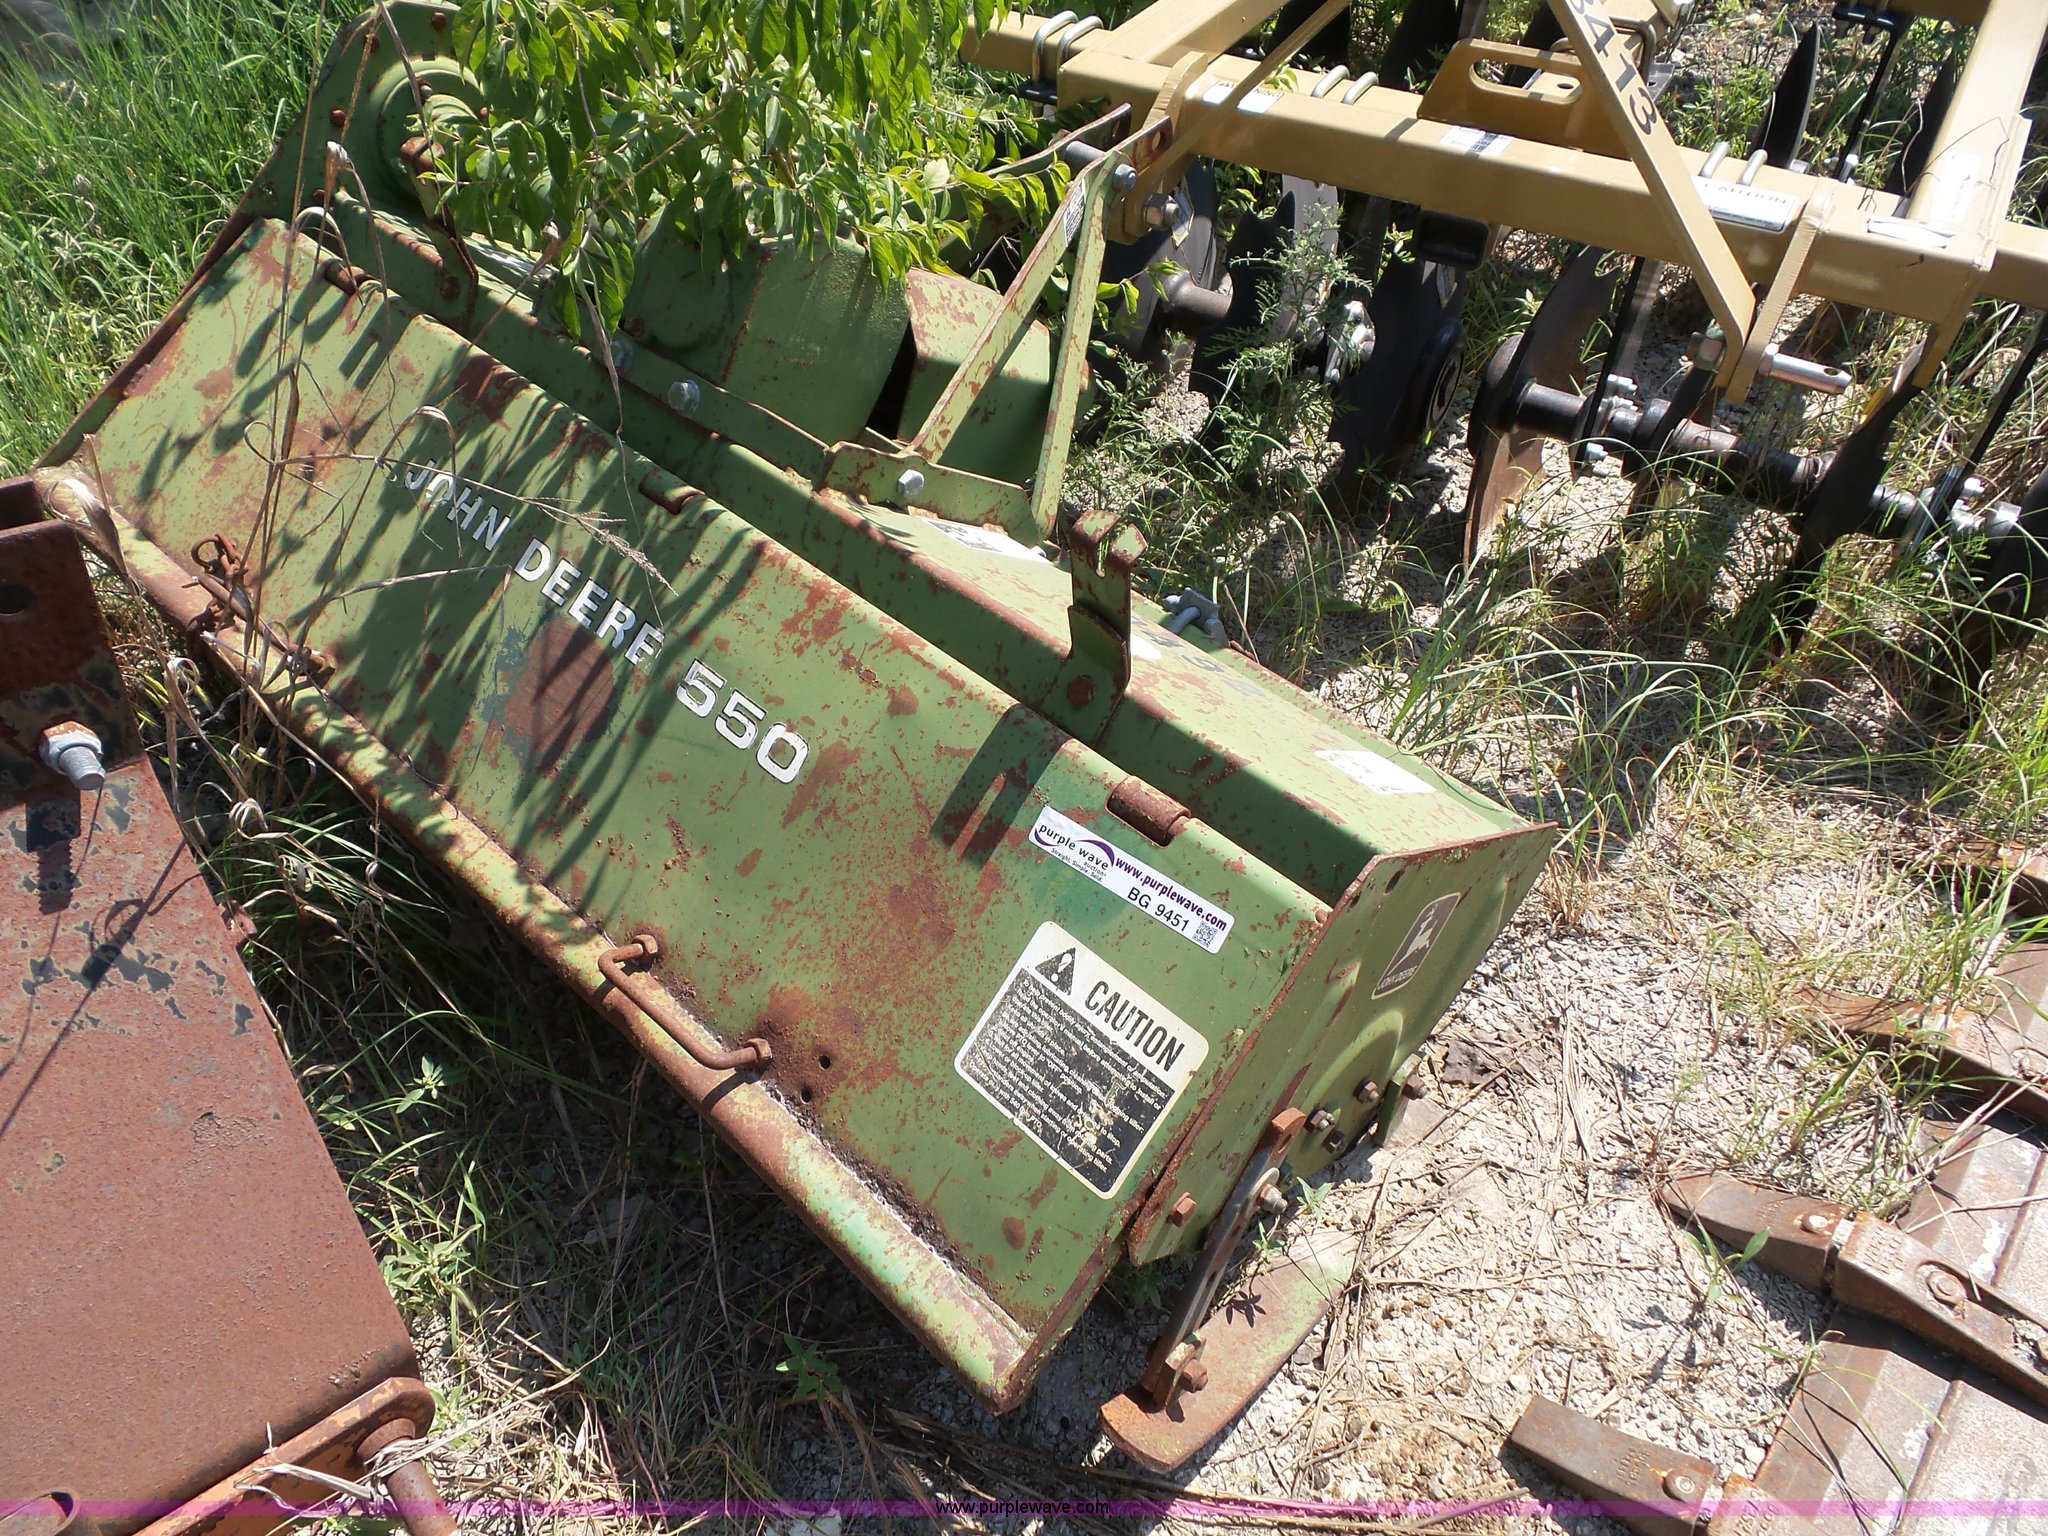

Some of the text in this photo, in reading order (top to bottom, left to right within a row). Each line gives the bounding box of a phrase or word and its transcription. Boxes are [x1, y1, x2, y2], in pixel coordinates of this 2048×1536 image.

[404, 458, 811, 784] JOHN DEERE 550
[1039, 824, 1110, 870] purple wave
[1115, 857, 1228, 932] www.purplewave.com
[1127, 887, 1190, 932] BG 9451
[1014, 1033, 1027, 1046] PTO
[1028, 984, 1040, 997] help
[1039, 993, 1060, 1012] prevent
[1058, 1008, 1076, 1025] bodily
[1089, 1034, 1127, 1068] entanglement
[1028, 999, 1038, 1010] the
[1063, 1028, 1084, 1047] manual
[1082, 1044, 1101, 1062] before
[1100, 1058, 1131, 1086] attempting
[1084, 980, 1186, 1072] CAUTION
[1009, 1097, 1020, 1109] 540
[1017, 1056, 1044, 1081] movement
[1066, 1098, 1078, 1110] and
[1017, 1079, 1029, 1091] and
[1027, 1088, 1049, 1109] clothing
[1048, 1106, 1062, 1121] away
[1068, 1068, 1092, 1090] cleaning
[1098, 1093, 1129, 1122] unogging
